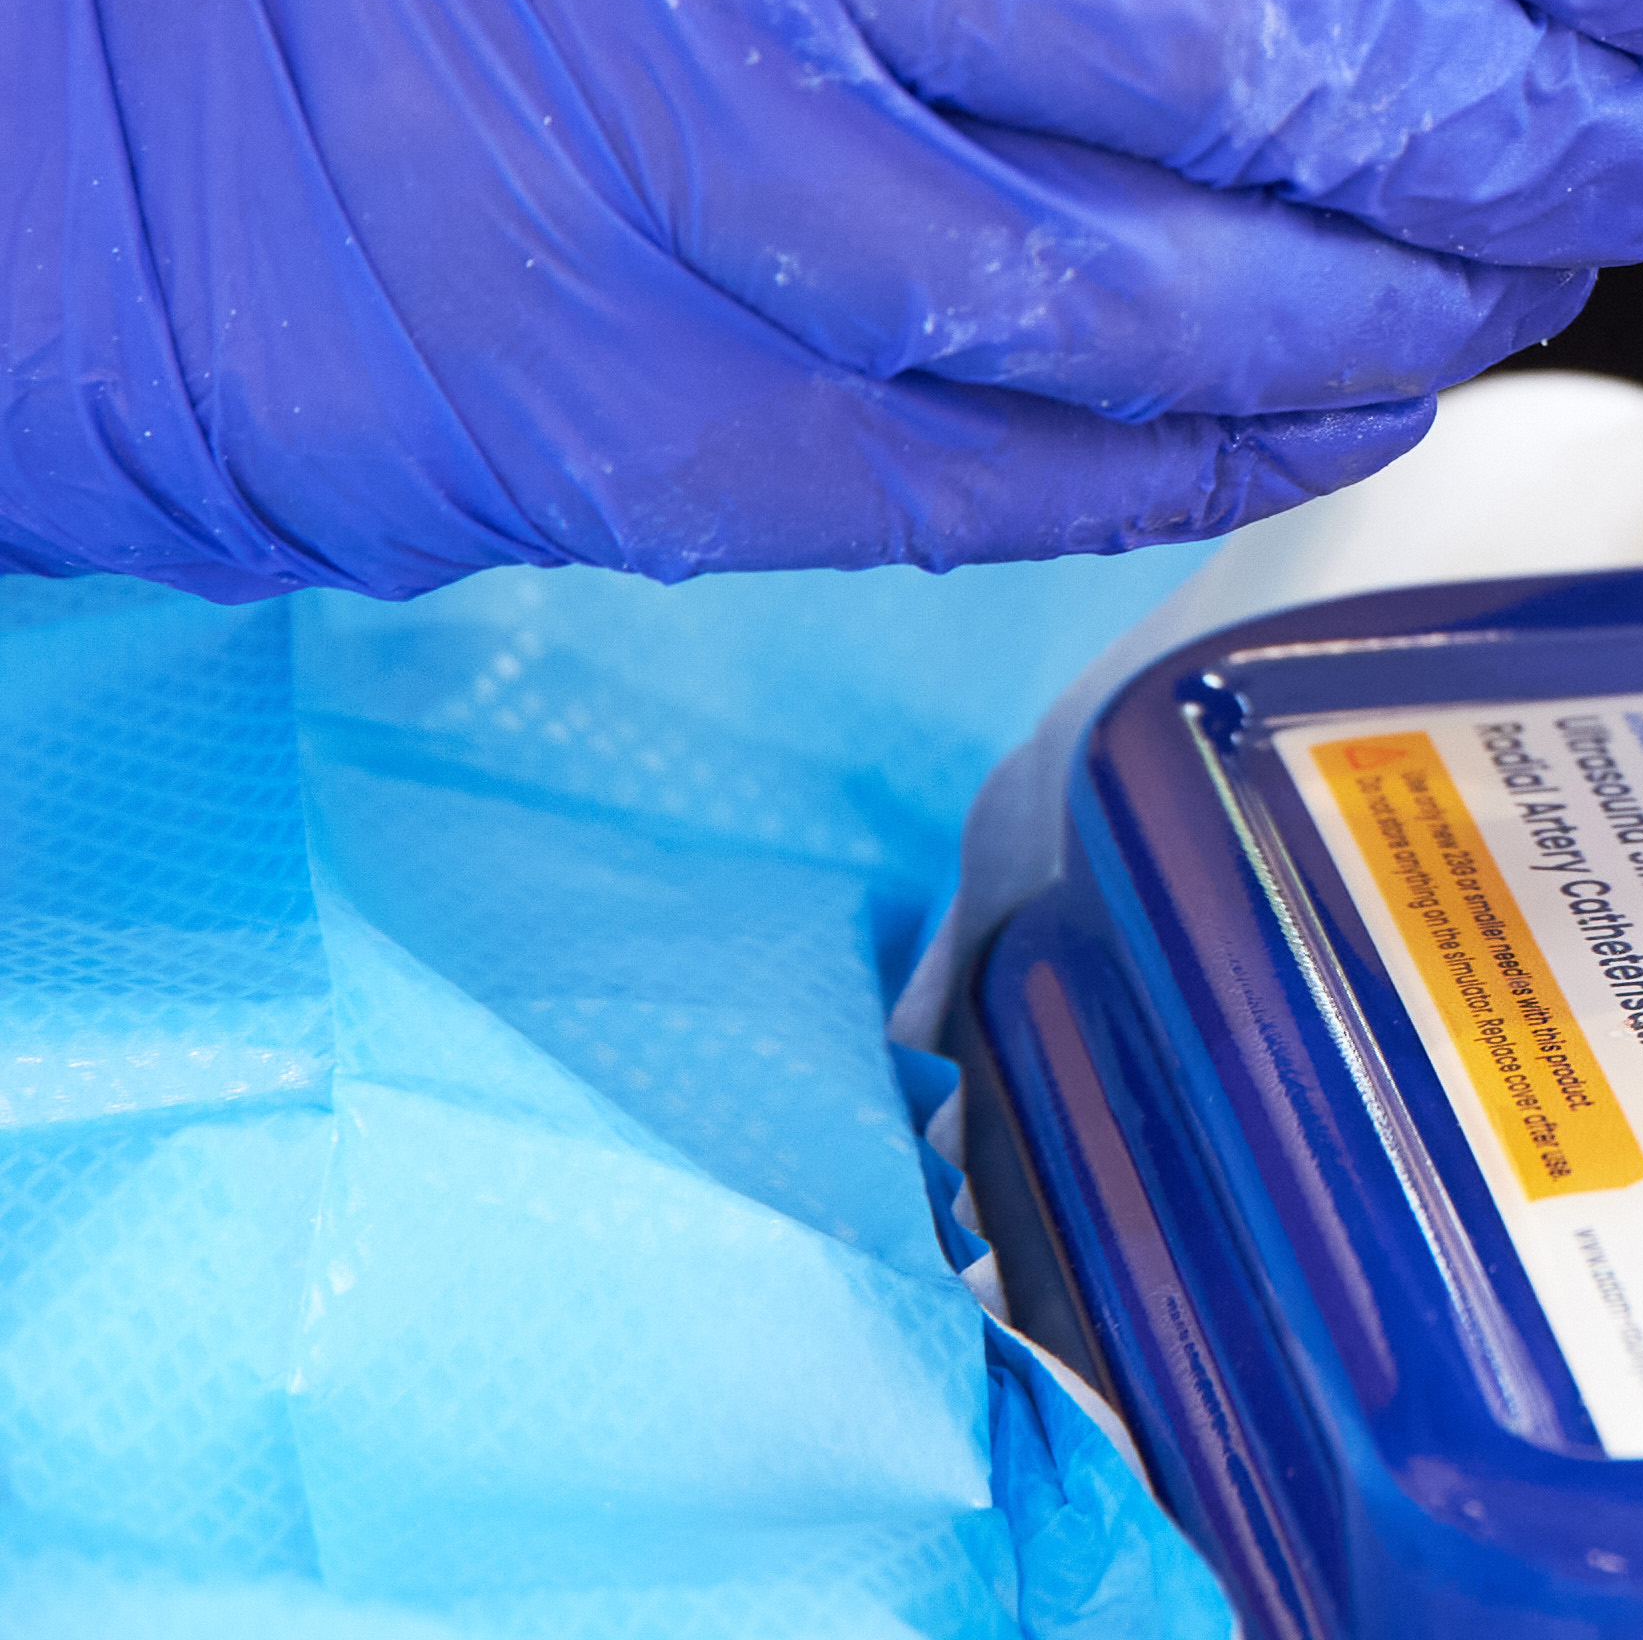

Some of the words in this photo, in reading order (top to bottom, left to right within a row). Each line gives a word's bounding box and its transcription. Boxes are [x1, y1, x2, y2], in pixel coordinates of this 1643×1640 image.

[1481, 722, 1559, 794] Radial
[1519, 803, 1591, 873] Artery
[1394, 850, 1440, 909] anything
[1456, 878, 1481, 891] or
[1423, 910, 1449, 926] on
[1433, 928, 1461, 949] the
[1464, 894, 1506, 941] smaller
[1443, 951, 1493, 1017] simulator.
[1490, 944, 1533, 995] needles
[1517, 997, 1552, 1025] with
[1476, 1017, 1522, 1072] Replace
[1532, 1027, 1565, 1052] this
[1505, 1074, 1542, 1110] cover
[1537, 1054, 1593, 1109] product.
[1524, 1115, 1559, 1146] after
